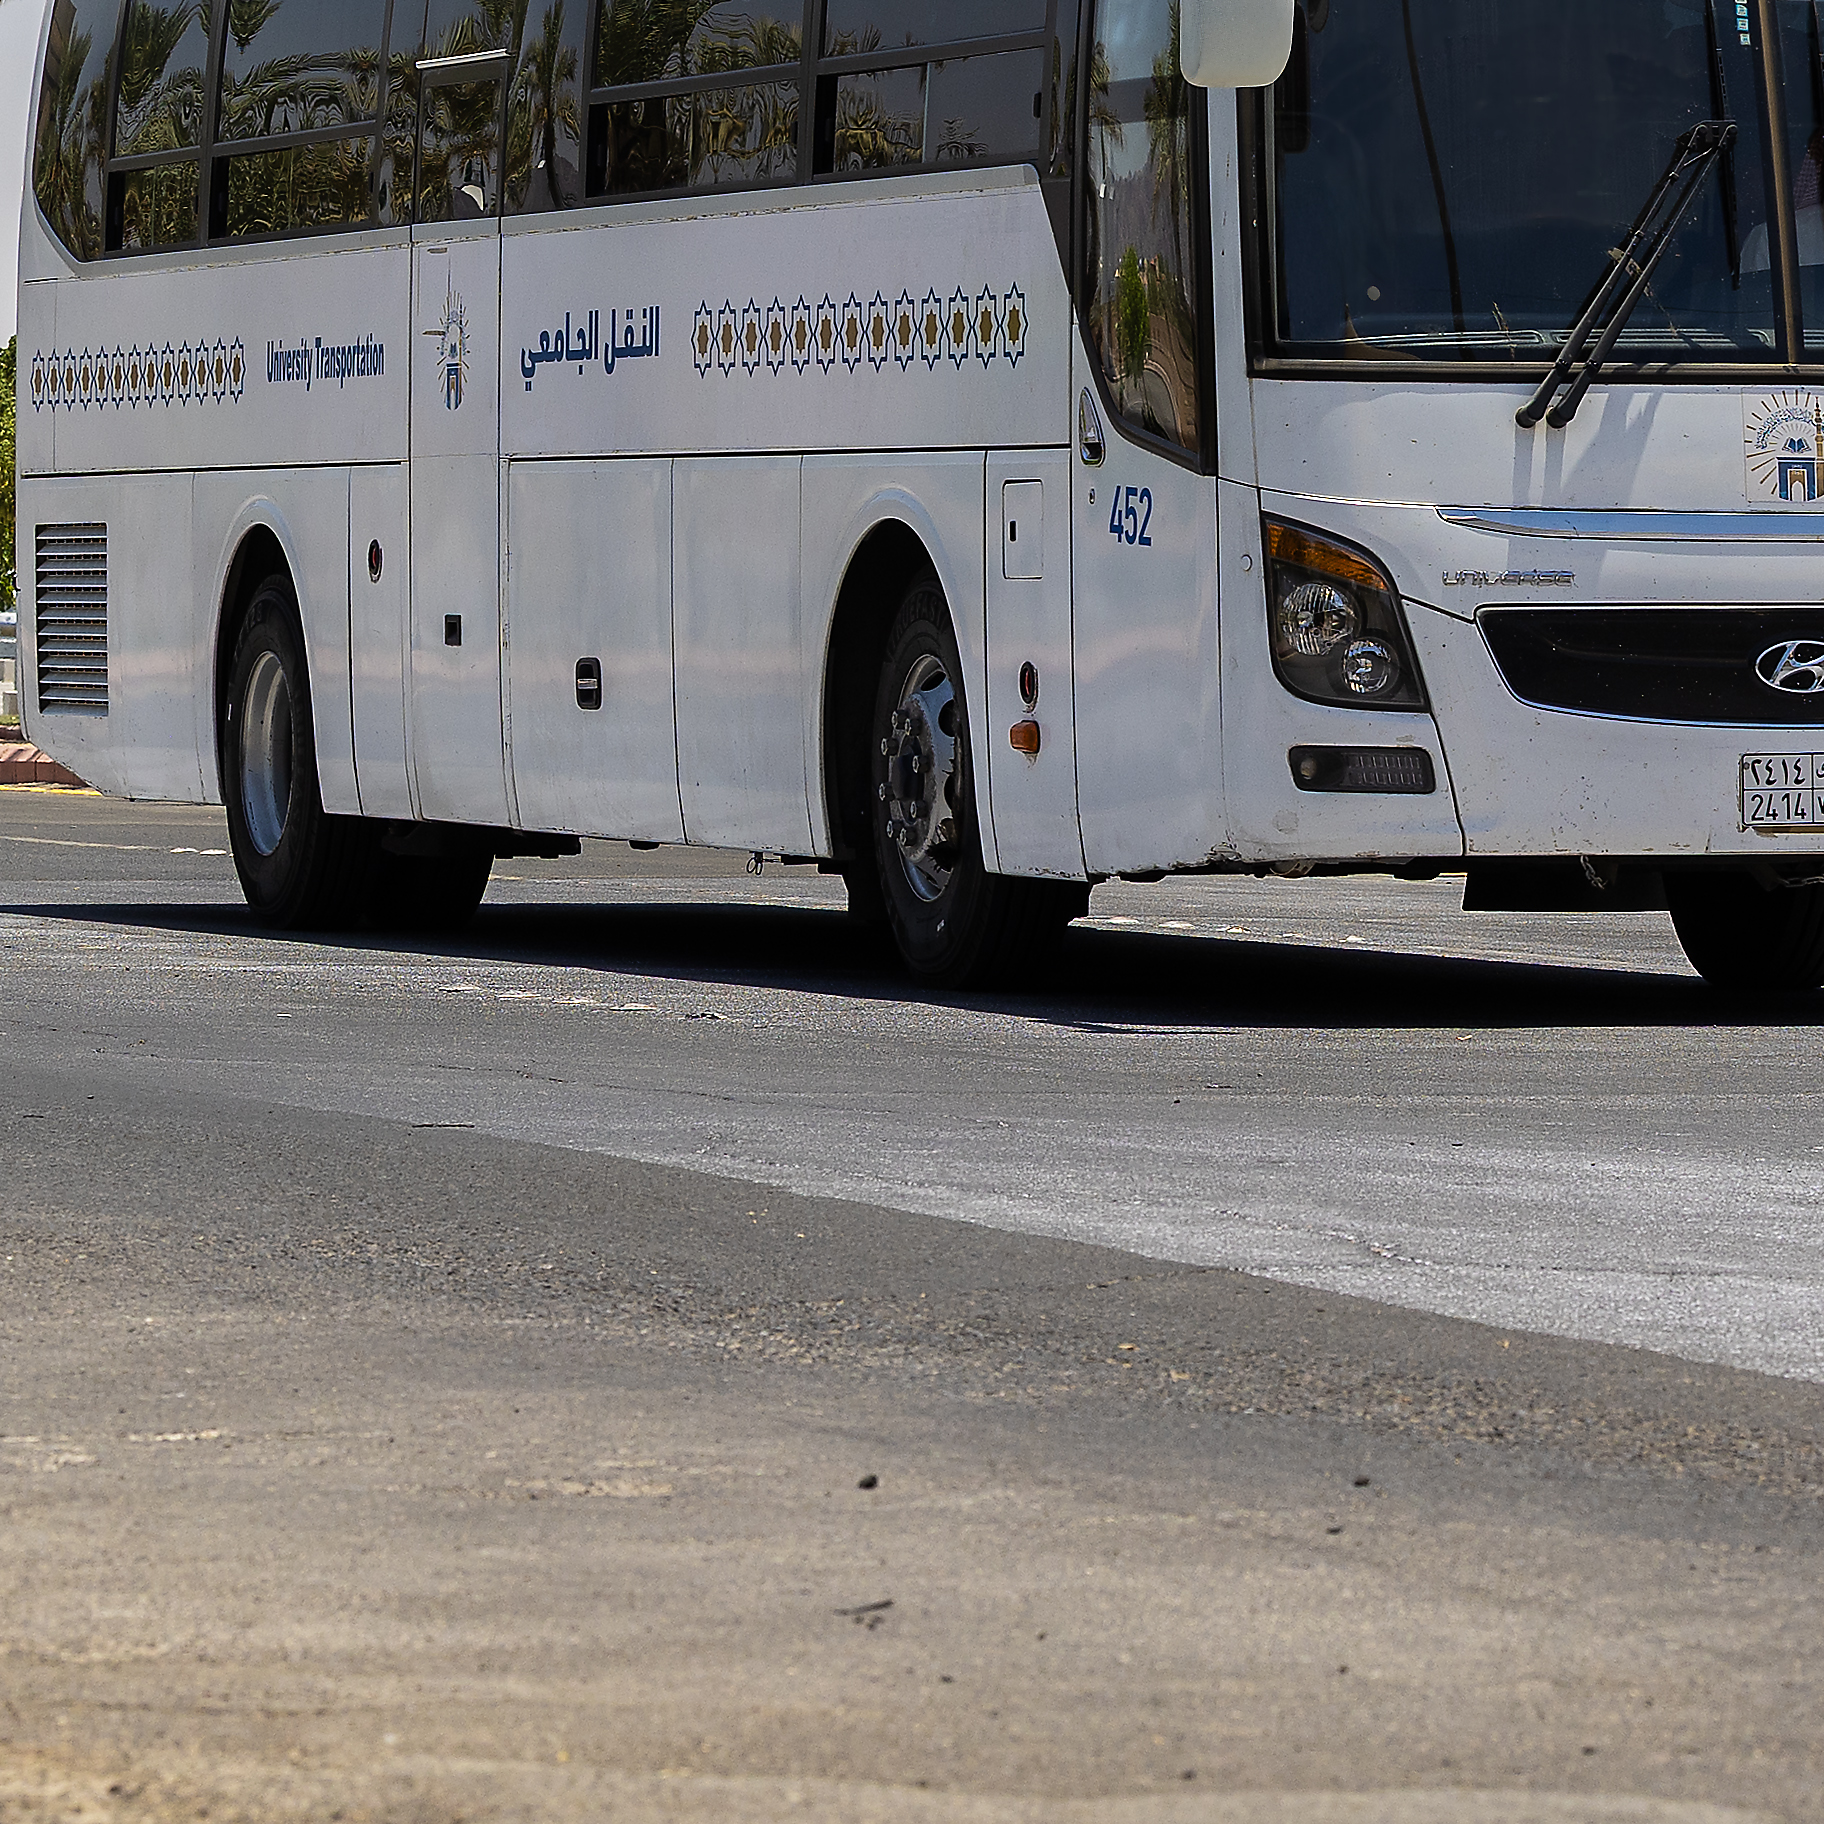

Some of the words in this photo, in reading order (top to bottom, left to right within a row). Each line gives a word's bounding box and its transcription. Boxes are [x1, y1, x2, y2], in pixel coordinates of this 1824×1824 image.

[266, 337, 313, 392] University
[315, 332, 384, 389] Transportation
[520, 309, 599, 392] الجامعي
[604, 305, 660, 375] النقل
[1108, 485, 1153, 547] 452
[1750, 757, 1806, 786] ٢٤١٤
[1750, 792, 1807, 822] 2414
